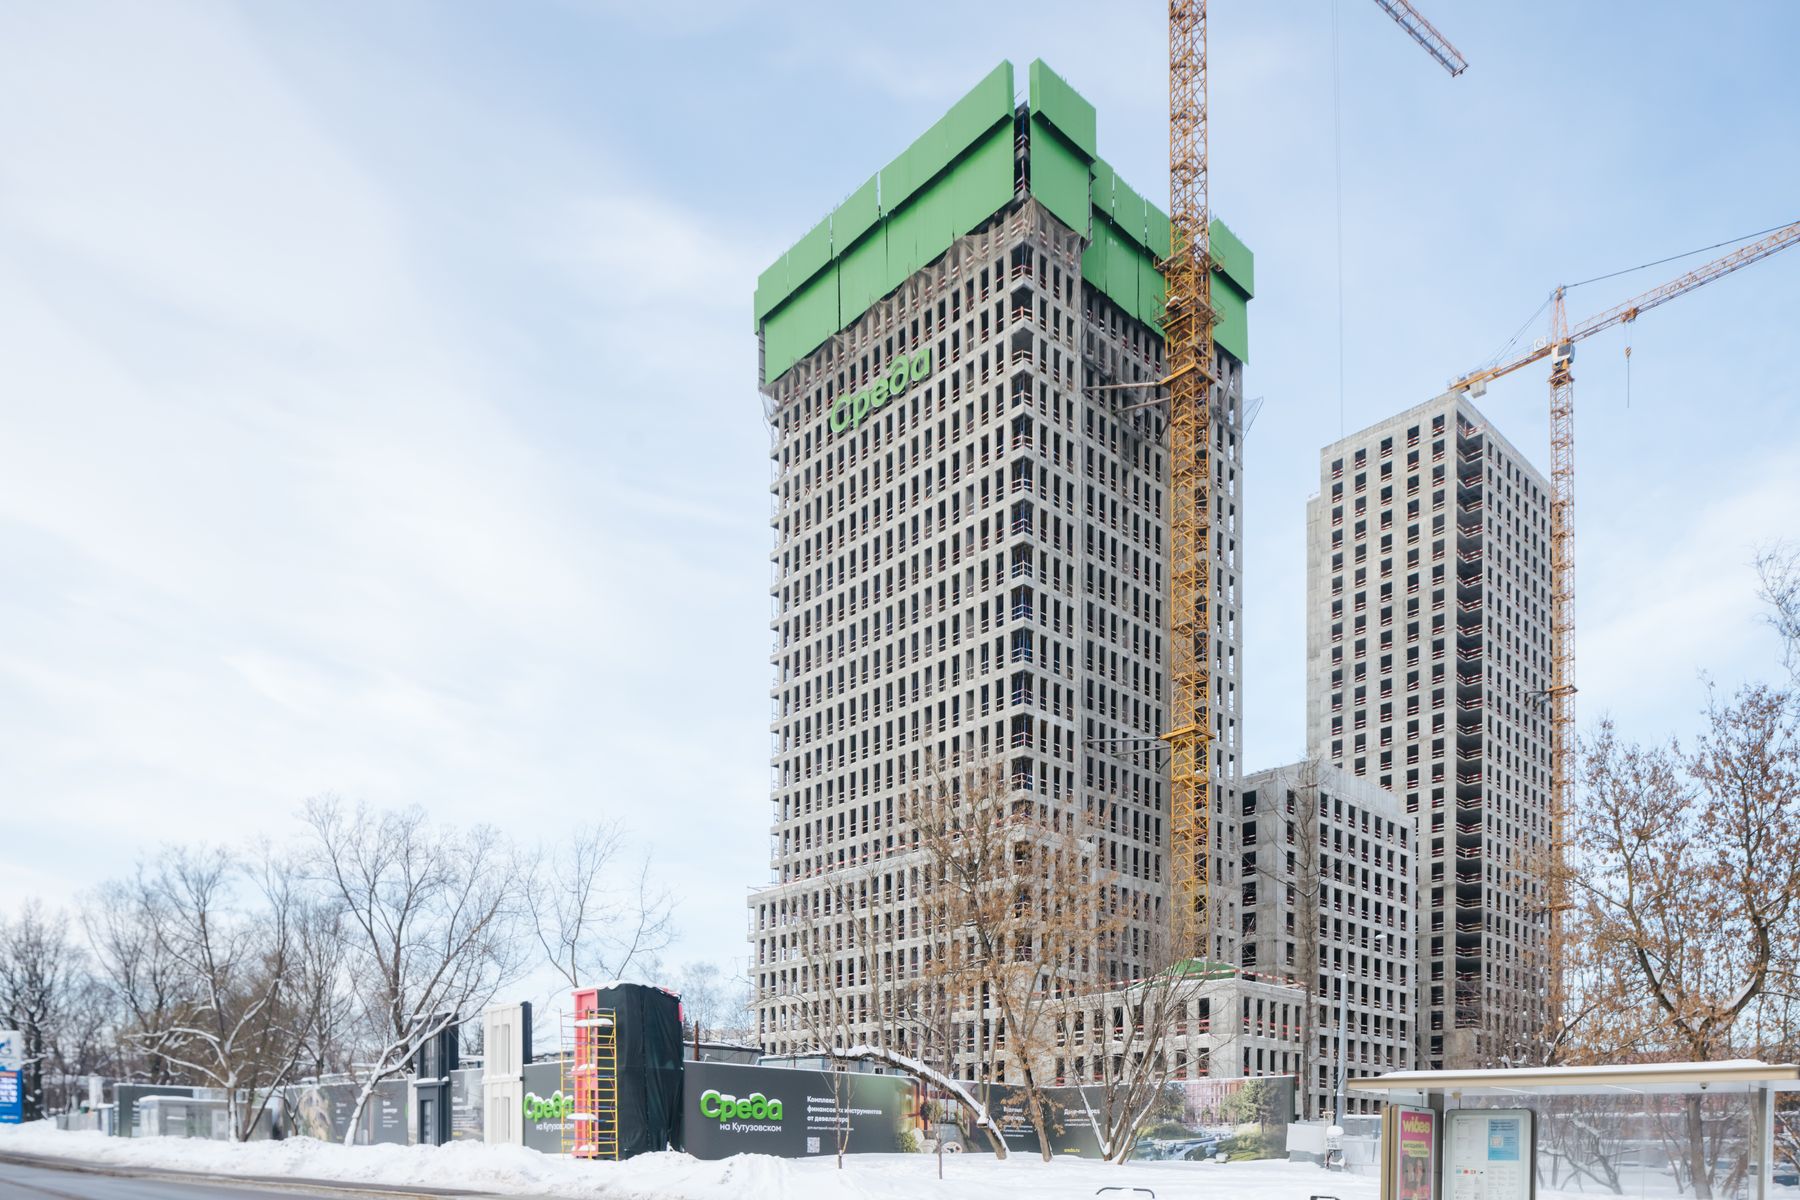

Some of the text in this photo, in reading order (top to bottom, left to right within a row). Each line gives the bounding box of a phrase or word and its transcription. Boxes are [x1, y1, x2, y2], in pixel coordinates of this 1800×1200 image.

[830, 348, 930, 432] Среда
[524, 1091, 574, 1122] Среда
[700, 1090, 783, 1122] Среда
[807, 1105, 843, 1113] финансовх
[732, 1122, 782, 1133] Кутузовском
